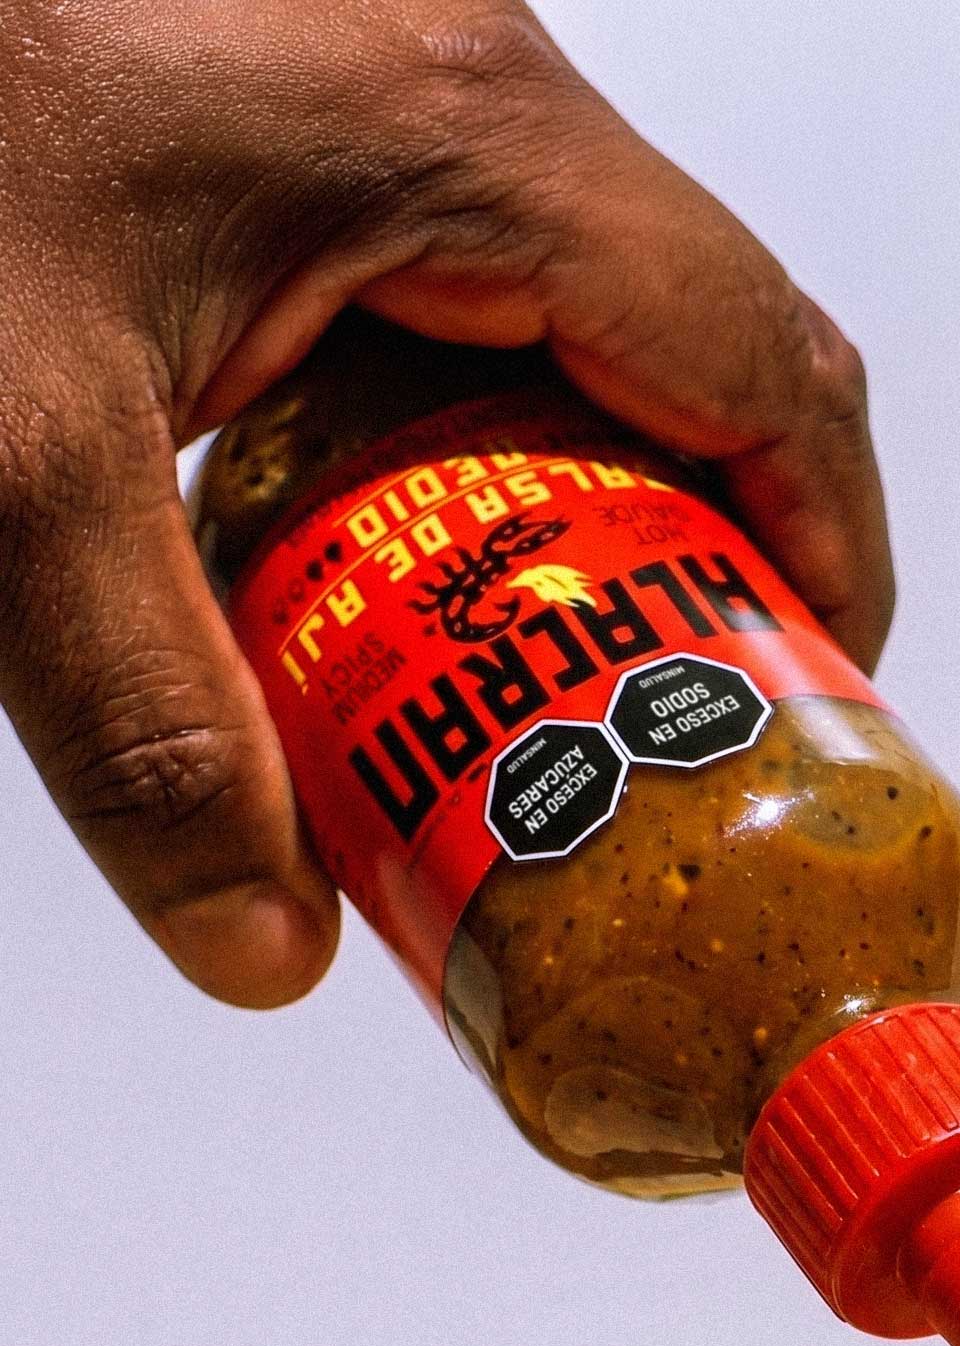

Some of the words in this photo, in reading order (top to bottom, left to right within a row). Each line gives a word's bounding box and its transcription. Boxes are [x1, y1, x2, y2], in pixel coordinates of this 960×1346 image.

[465, 460, 677, 525] ALSA
[373, 513, 452, 583] DE
[281, 578, 367, 696] AJÍ
[320, 632, 385, 698] SPICY
[639, 665, 685, 689] MINSALUD
[650, 682, 711, 718] SODIO
[679, 695, 740, 732] EXCESO
[506, 737, 547, 774] MINSALUD
[648, 729, 677, 746] EN
[508, 744, 586, 819] AZÚCARES
[549, 763, 598, 814] EXCESO
[524, 813, 549, 834] EN
